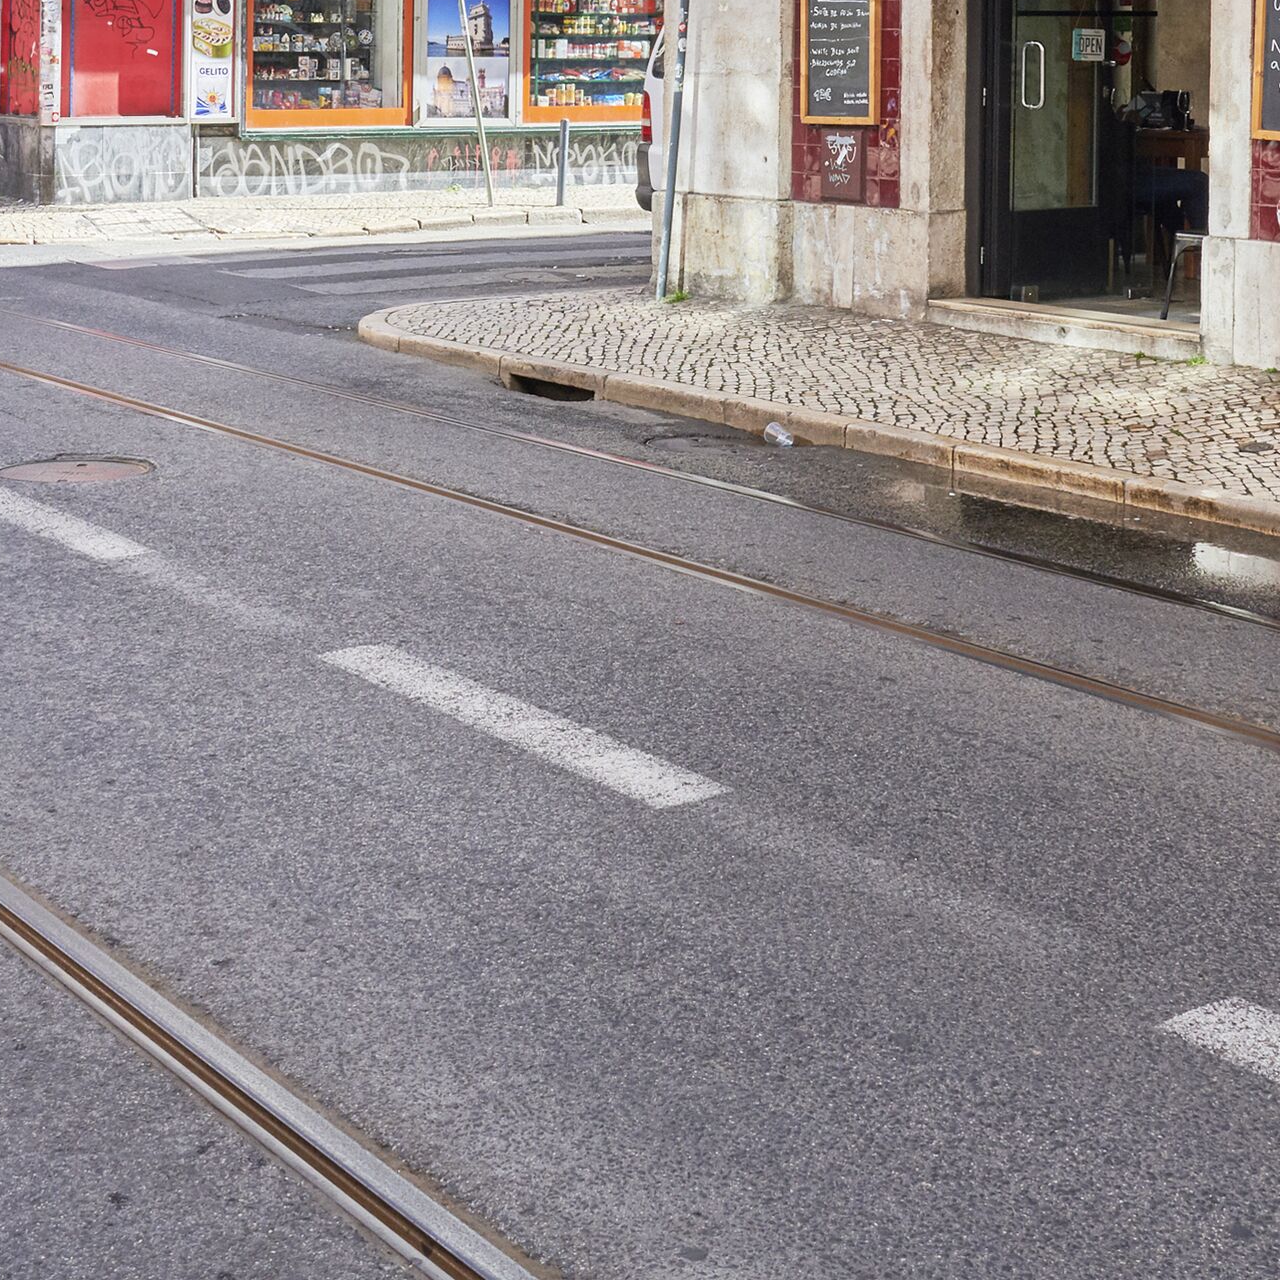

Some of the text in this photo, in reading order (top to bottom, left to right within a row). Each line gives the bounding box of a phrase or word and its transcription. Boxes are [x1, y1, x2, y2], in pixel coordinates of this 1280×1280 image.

[1079, 37, 1102, 53] OPEN
[1271, 60, 1280, 70] a
[199, 67, 229, 76] GELITO
